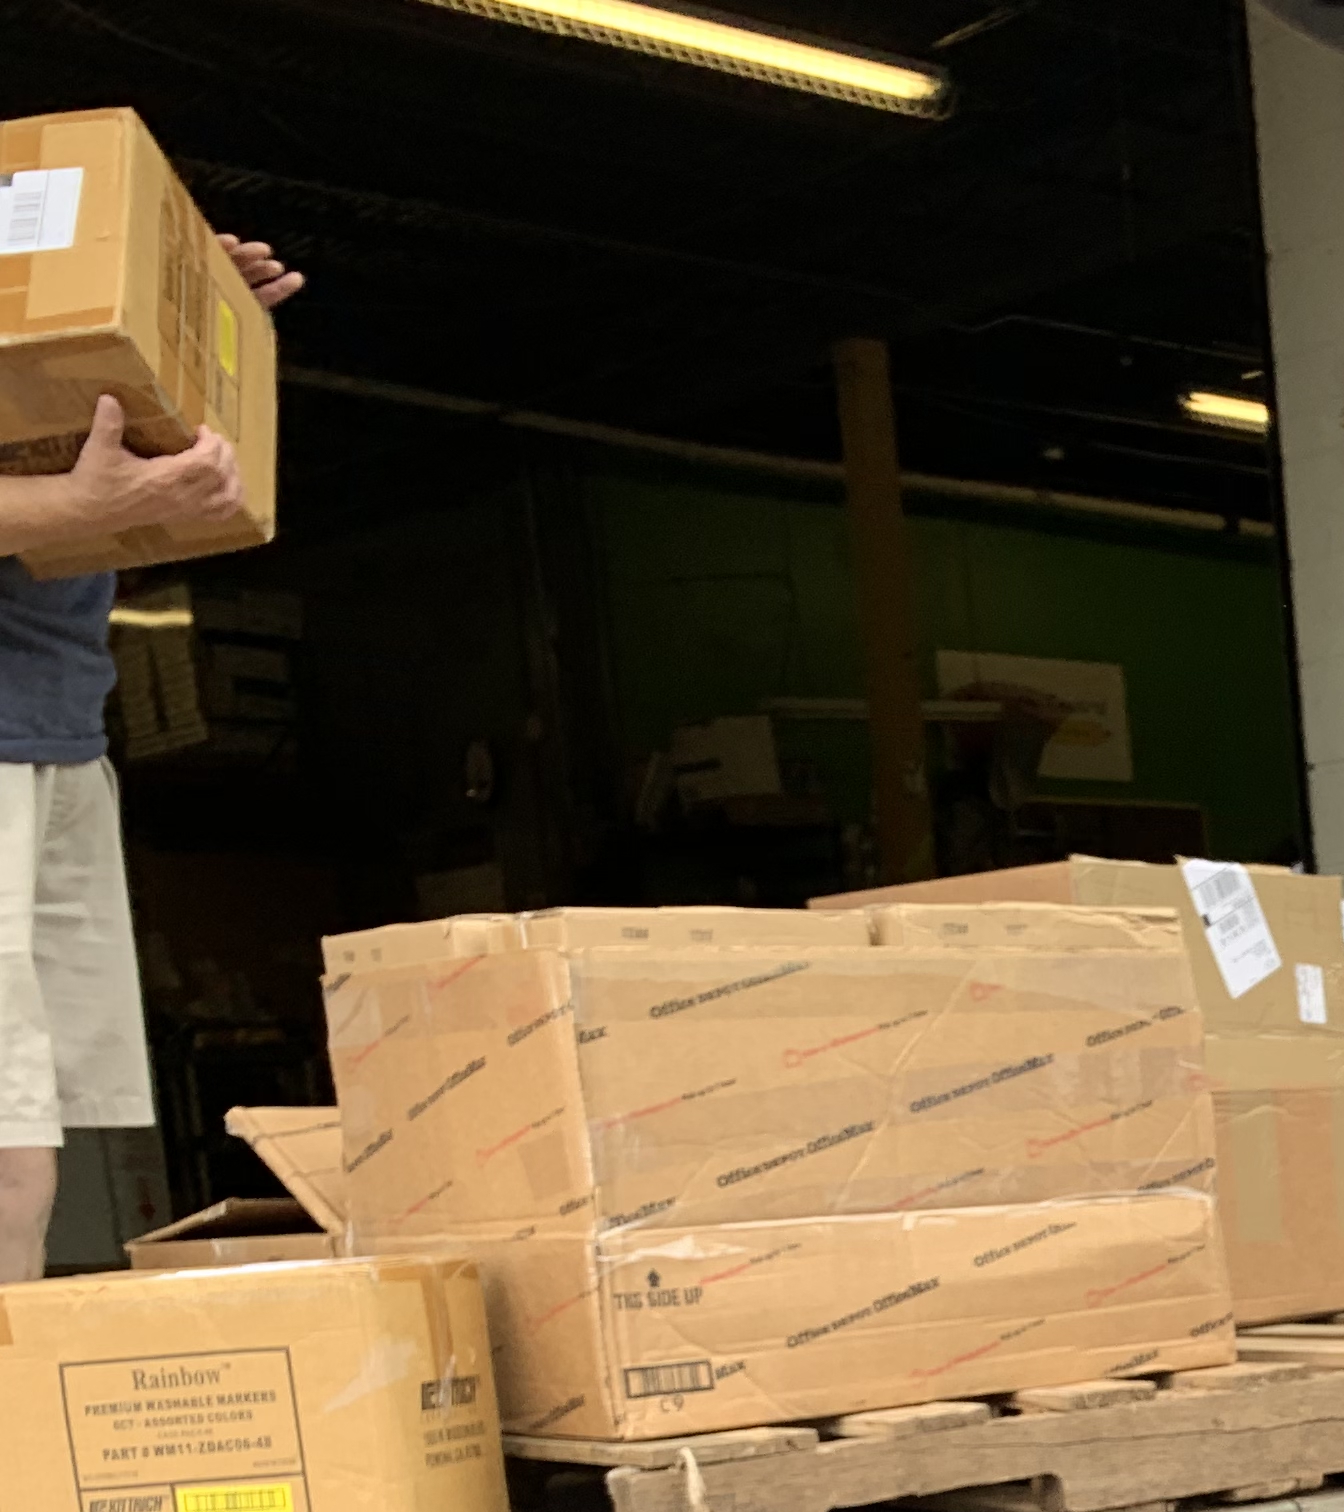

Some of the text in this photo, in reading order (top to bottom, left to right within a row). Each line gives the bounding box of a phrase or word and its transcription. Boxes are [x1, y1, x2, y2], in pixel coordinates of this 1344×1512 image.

[716, 1164, 758, 1189] Office
[647, 1288, 681, 1308] SIDE
[684, 1286, 703, 1306] UP
[786, 1325, 831, 1348] Office
[131, 1364, 223, 1392] Rainbow
[84, 1390, 277, 1417] PREMIUM WASHABLE MARKERS
[144, 1413, 205, 1428] ASSORTED
[206, 1409, 254, 1424] COLORS
[101, 1446, 139, 1462] PART
